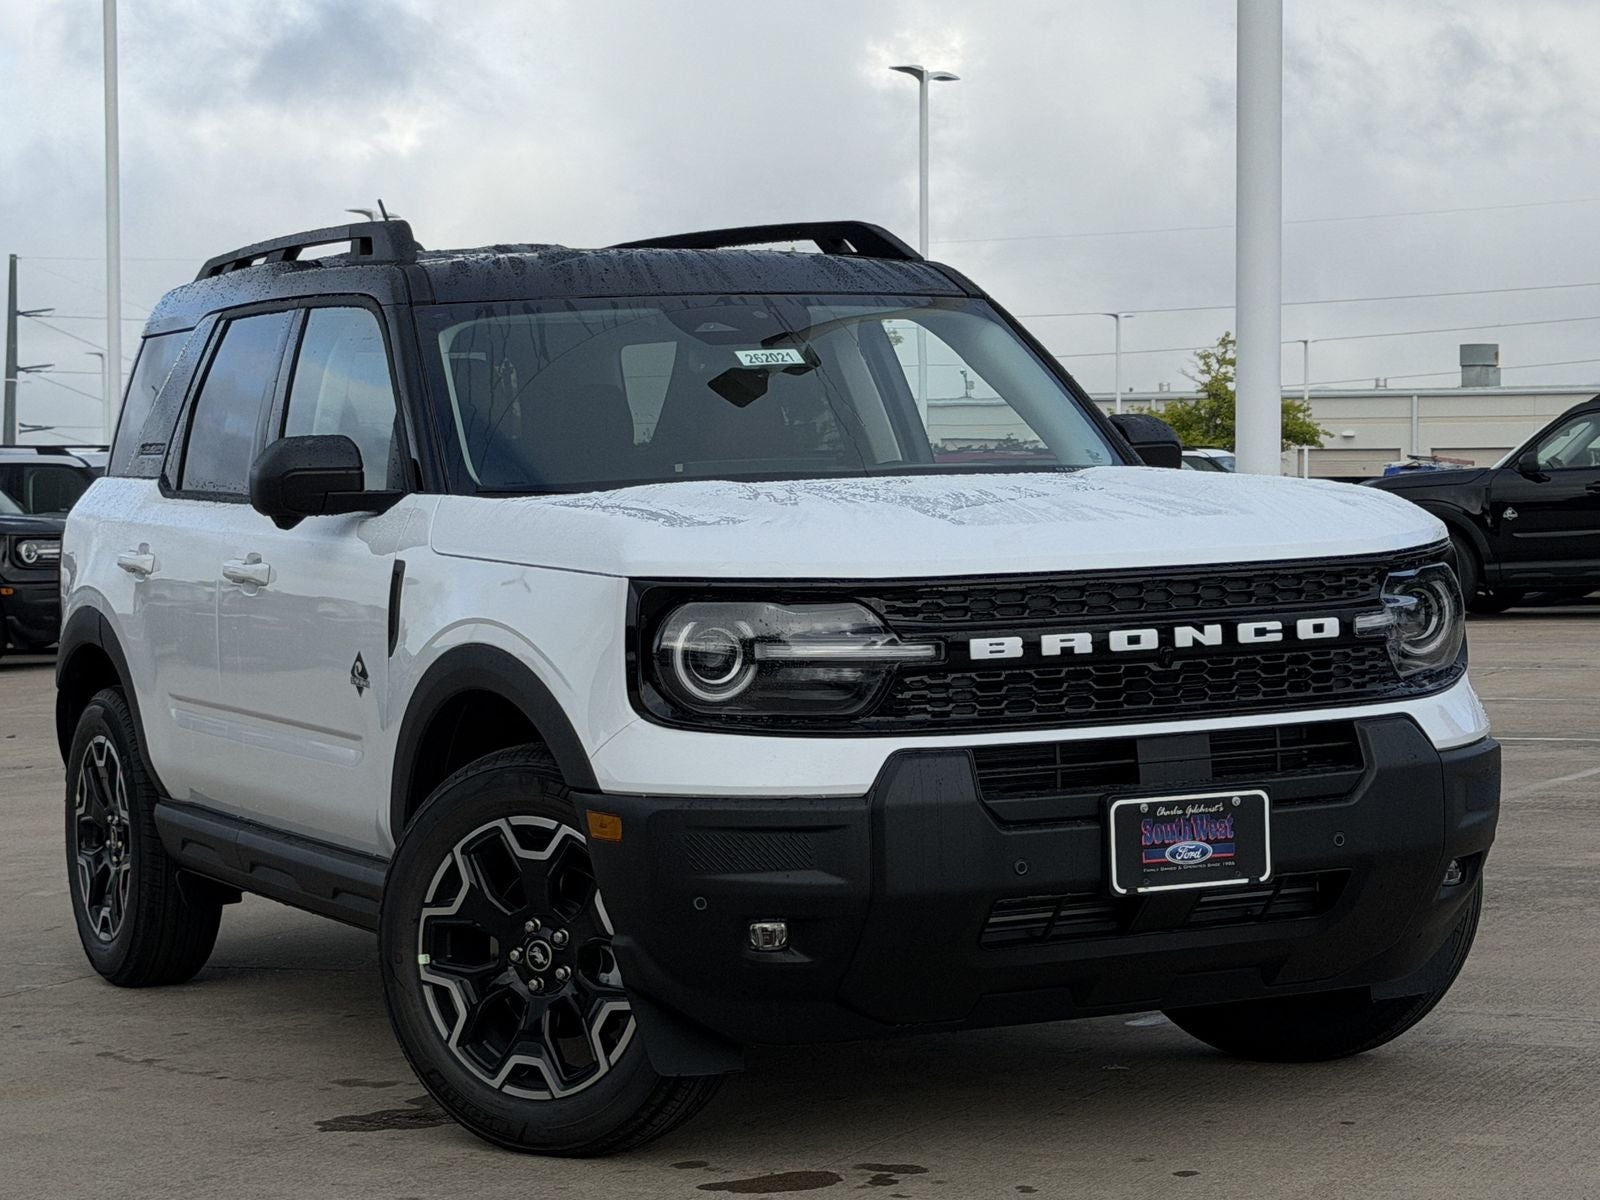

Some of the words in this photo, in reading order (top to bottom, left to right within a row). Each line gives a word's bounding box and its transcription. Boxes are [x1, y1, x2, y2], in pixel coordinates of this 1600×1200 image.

[744, 352, 796, 364] 262021
[969, 616, 1341, 661] BRONCO
[1156, 806, 1183, 816] Charlie
[1175, 845, 1201, 860] Ford
